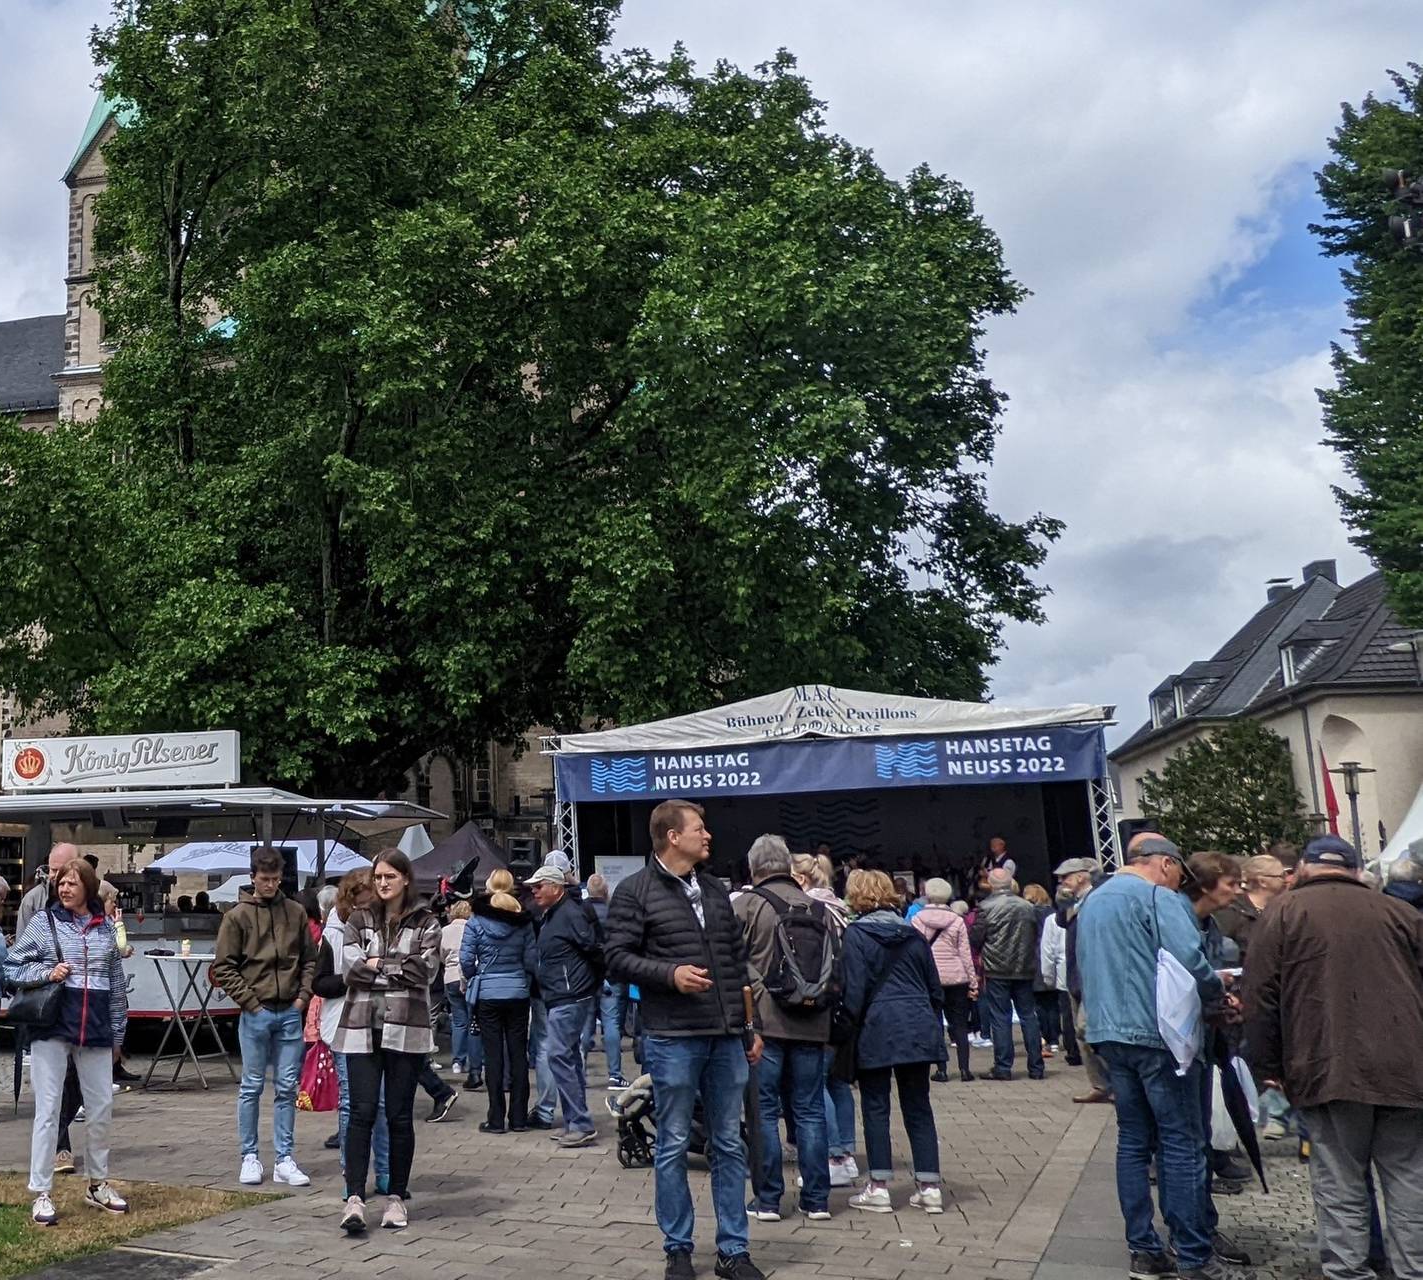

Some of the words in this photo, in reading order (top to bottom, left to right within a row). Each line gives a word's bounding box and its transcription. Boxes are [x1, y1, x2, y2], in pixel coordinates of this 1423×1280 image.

[793, 685, 841, 702] M.A.C.
[727, 712, 784, 729] Bühnen
[795, 706, 834, 719] Zelte
[846, 708, 918, 721] Pavillons
[945, 736, 1051, 755] HANSETAG
[60, 744, 130, 776] König
[129, 737, 219, 766] Pilsener
[654, 752, 749, 770] HANSETAG
[948, 759, 1012, 776] NEUSS
[1016, 757, 1066, 774] 2022
[655, 774, 713, 790] NEUSS
[717, 772, 761, 787] 2022
